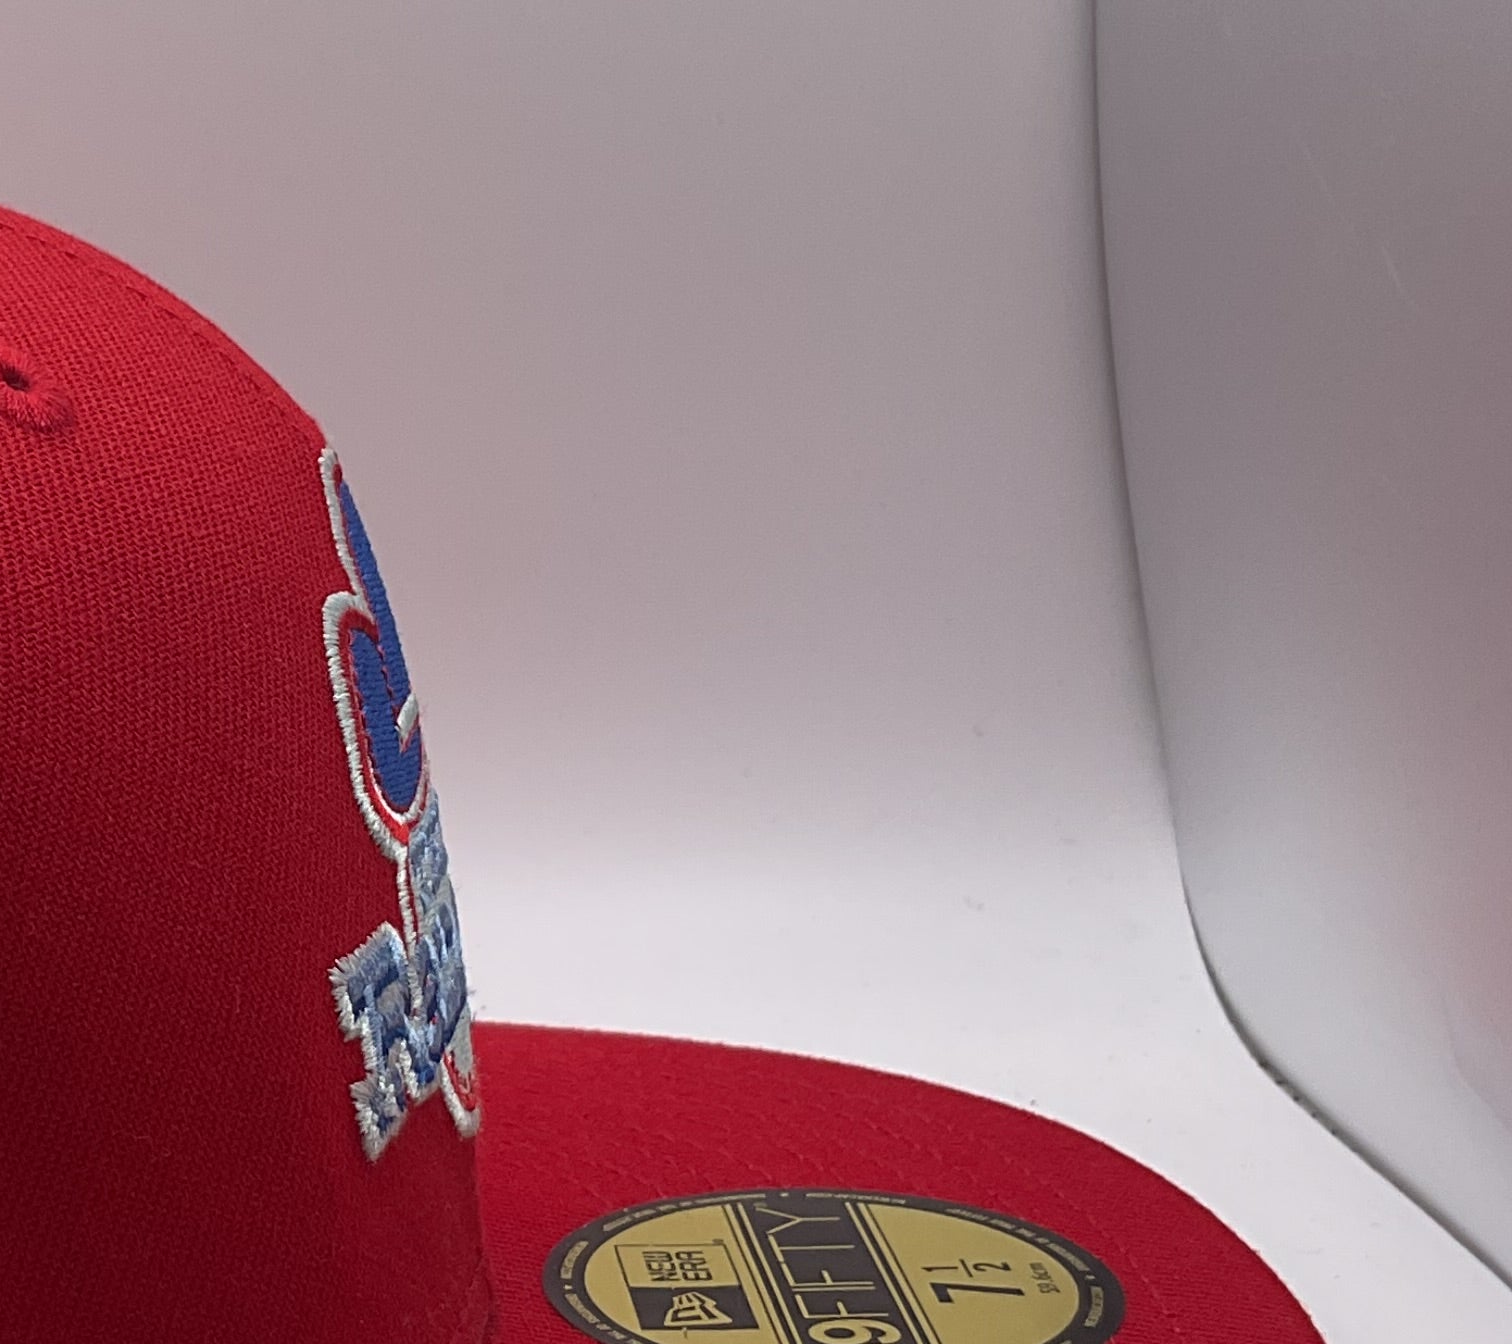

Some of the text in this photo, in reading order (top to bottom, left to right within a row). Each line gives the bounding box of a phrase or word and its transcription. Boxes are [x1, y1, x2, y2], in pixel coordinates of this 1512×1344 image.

[642, 1250, 681, 1283] NEW
[674, 1250, 713, 1283] ERA
[929, 1282, 1025, 1304] 7
